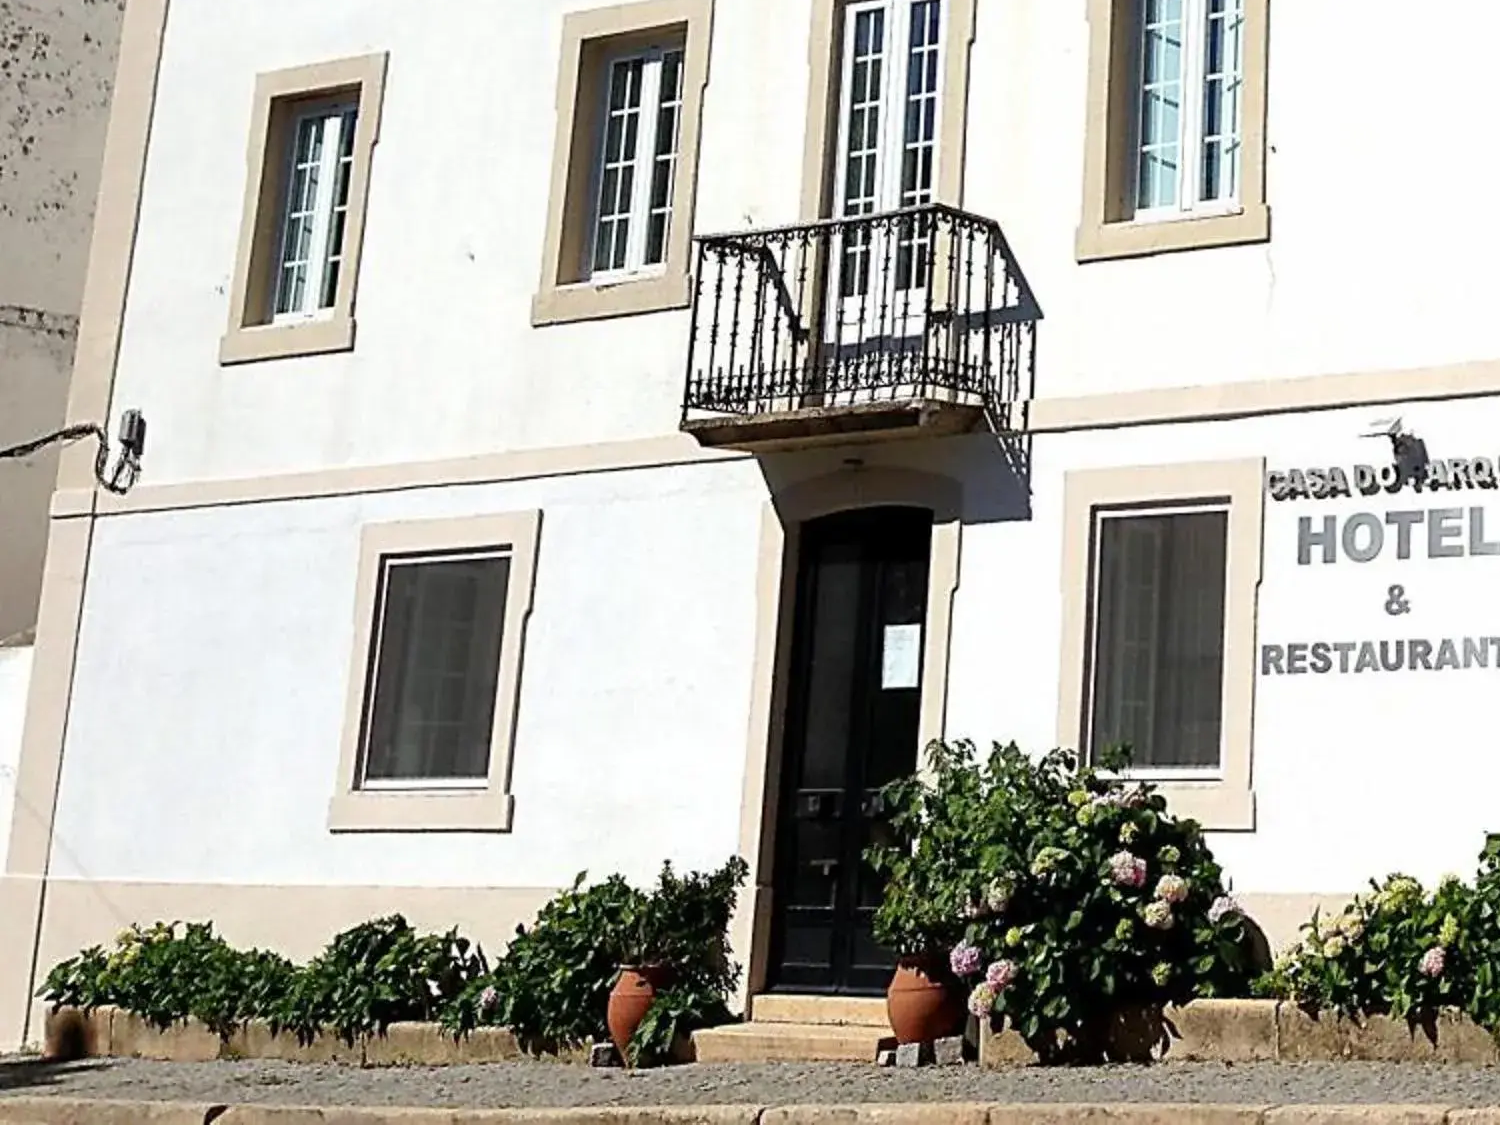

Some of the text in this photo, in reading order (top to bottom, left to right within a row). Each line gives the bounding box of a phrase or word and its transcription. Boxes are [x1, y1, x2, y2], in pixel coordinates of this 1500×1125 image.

[1266, 467, 1351, 500] CASA
[1353, 465, 1401, 496] DO
[1384, 584, 1411, 616] &
